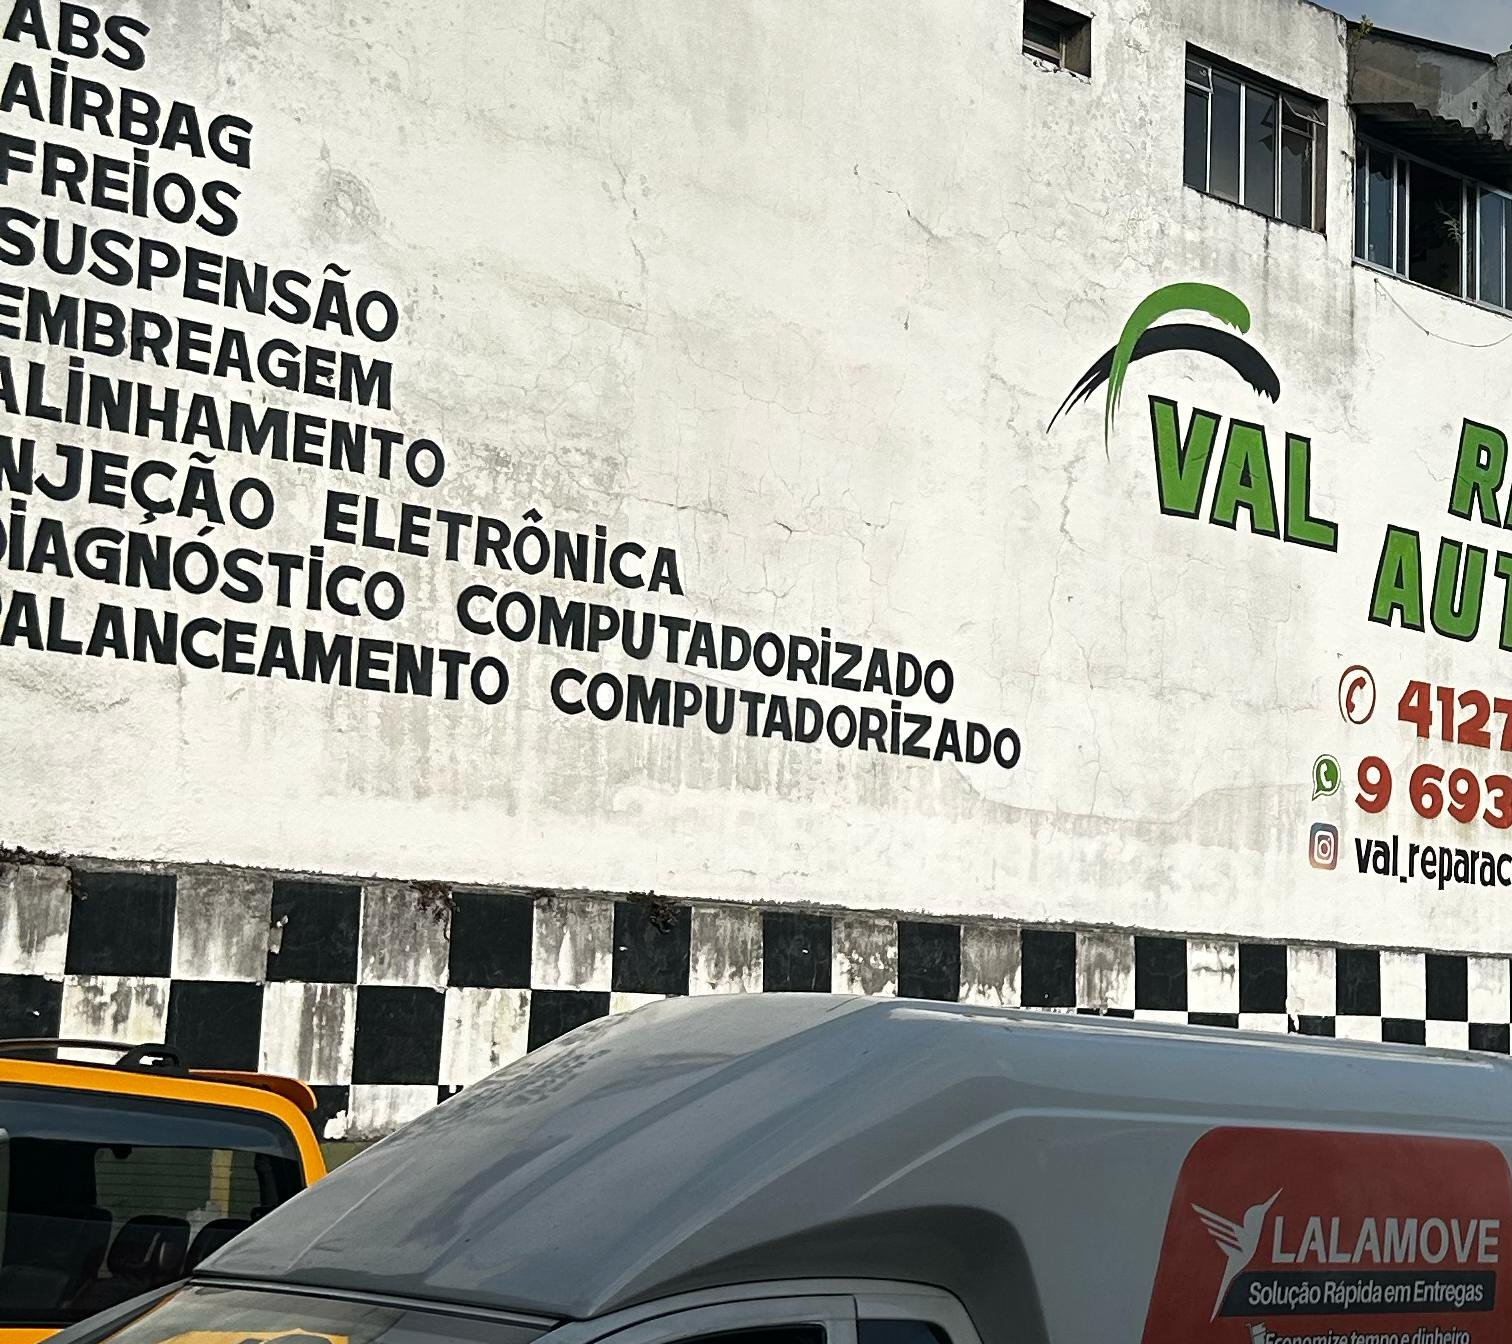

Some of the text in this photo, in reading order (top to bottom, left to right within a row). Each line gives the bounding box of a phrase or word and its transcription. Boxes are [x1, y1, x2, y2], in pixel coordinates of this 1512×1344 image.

[0, 59, 254, 169] AIRBAG
[0, 134, 240, 238] FREIOS
[0, 207, 399, 343] SUSPENSÃO
[0, 285, 393, 410] EMBREAGEM
[1149, 394, 1338, 553] VAL
[324, 489, 684, 596] ELETRÔNICA
[0, 500, 954, 704] IAGNÓSTICO COMPUTADORIZADO
[0, 590, 1021, 769] ALANCEAMENTO COMPUTADORIZADO
[1356, 756, 1392, 813] 9
[1249, 1280, 1484, 1309] Solução Rápida em Entregas
[1271, 1216, 1500, 1264] LALAMOVE
